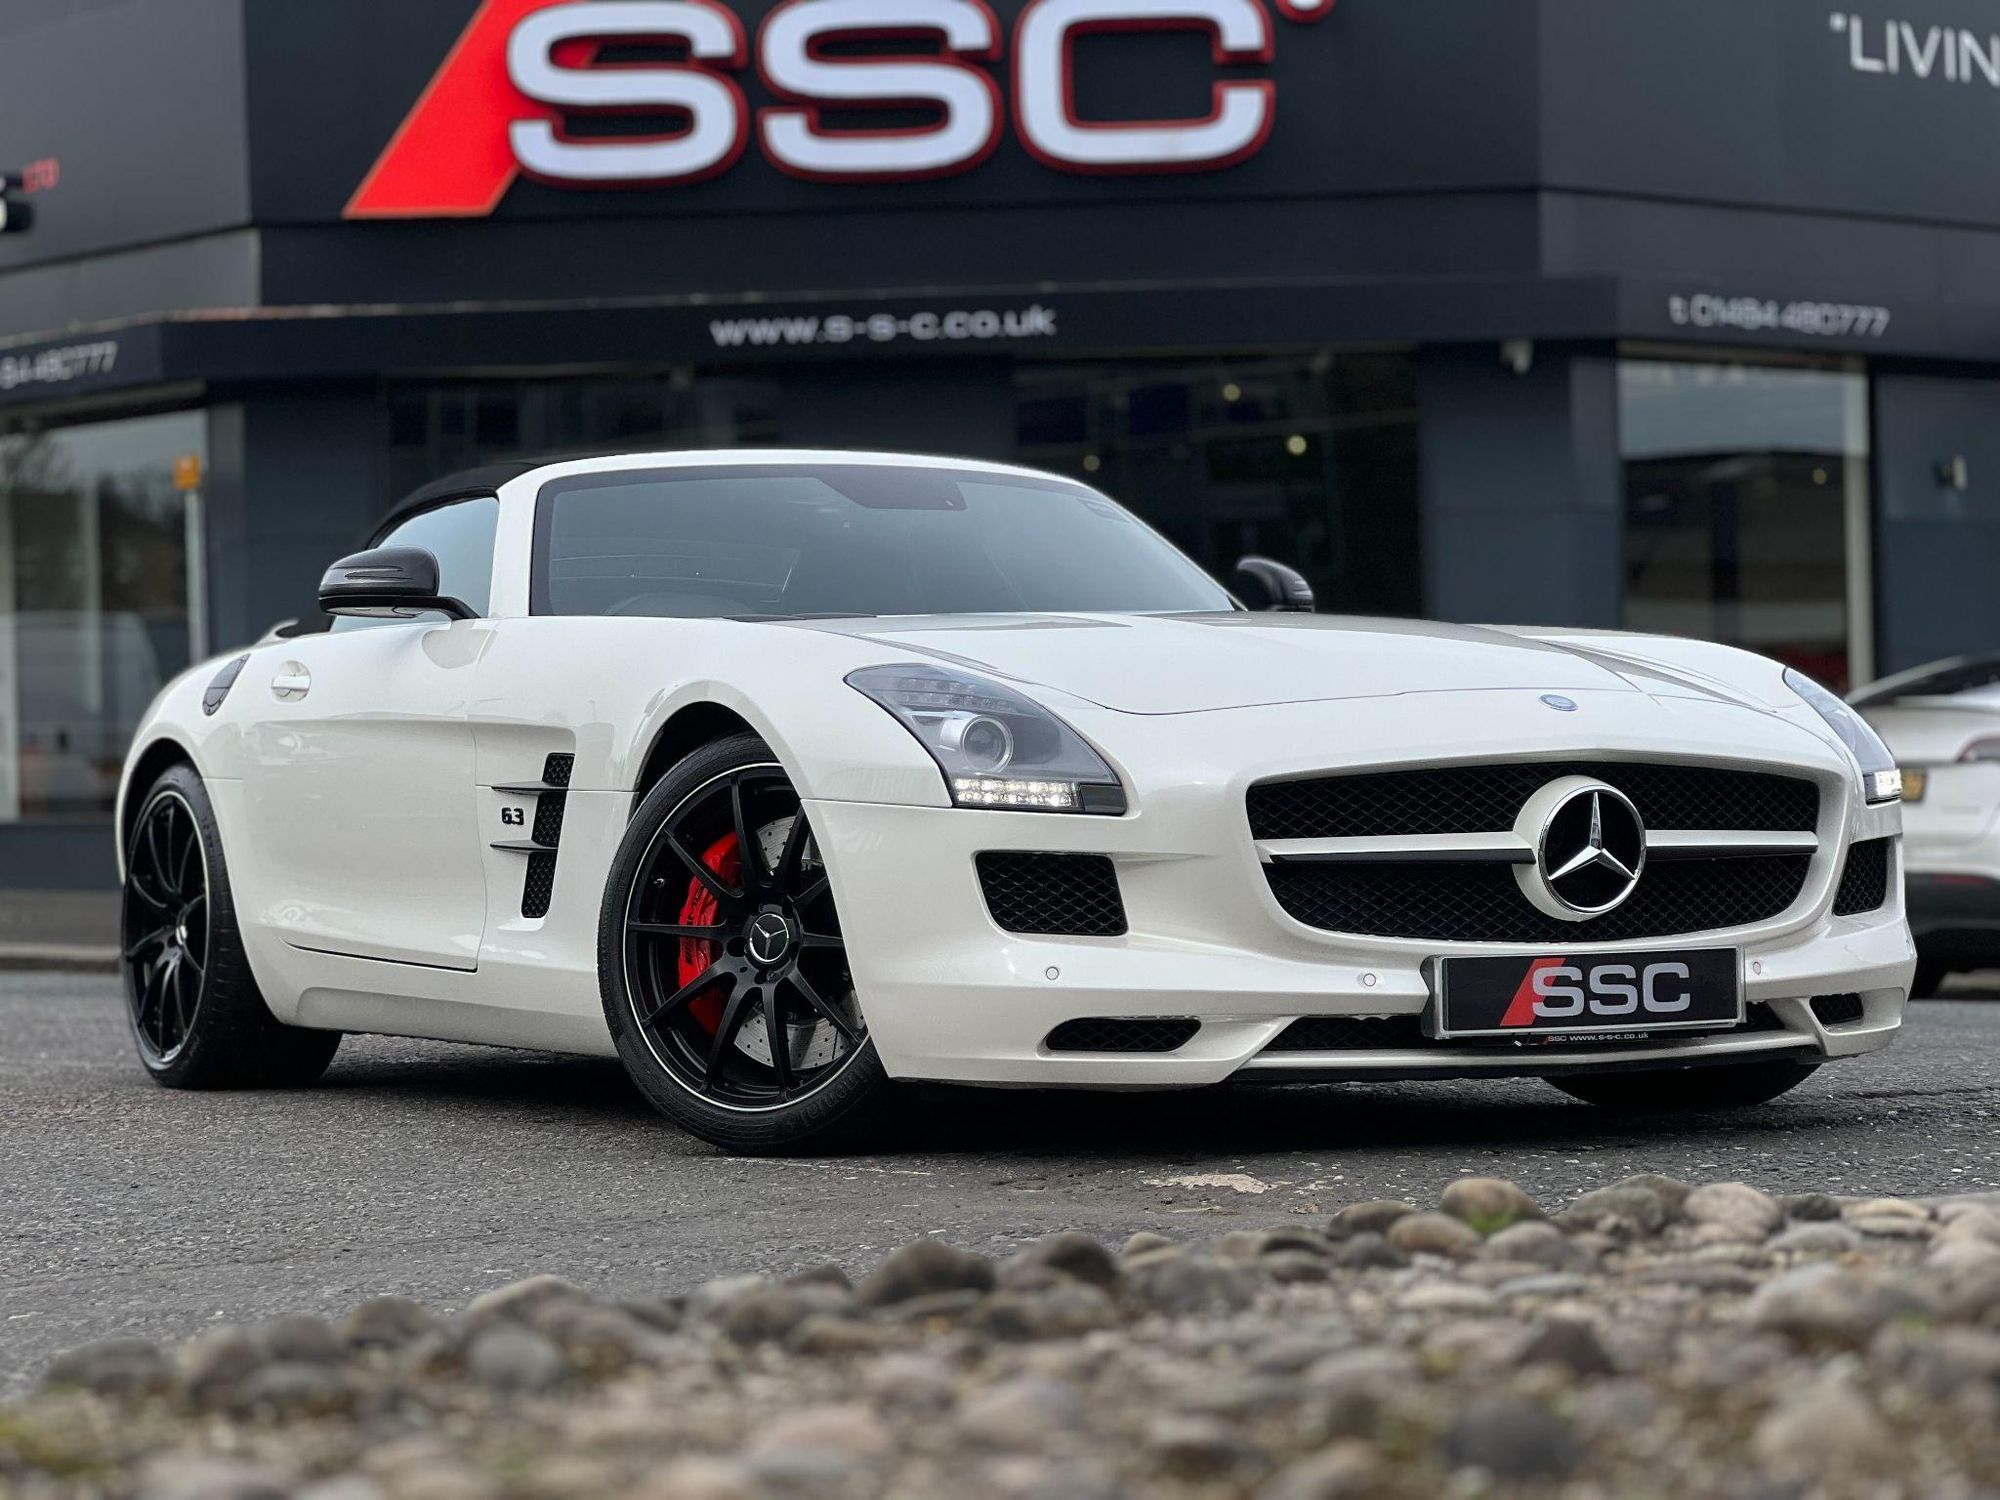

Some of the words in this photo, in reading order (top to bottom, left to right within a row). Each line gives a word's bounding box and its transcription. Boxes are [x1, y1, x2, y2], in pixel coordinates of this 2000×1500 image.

[506, 0, 1274, 184] SSC
[708, 304, 1057, 347] www.s-s-c.co.uk
[501, 807, 525, 826] 63
[1532, 961, 1691, 1018] SSC
[1569, 1031, 1649, 1042] www.s-s-c.co.uk
